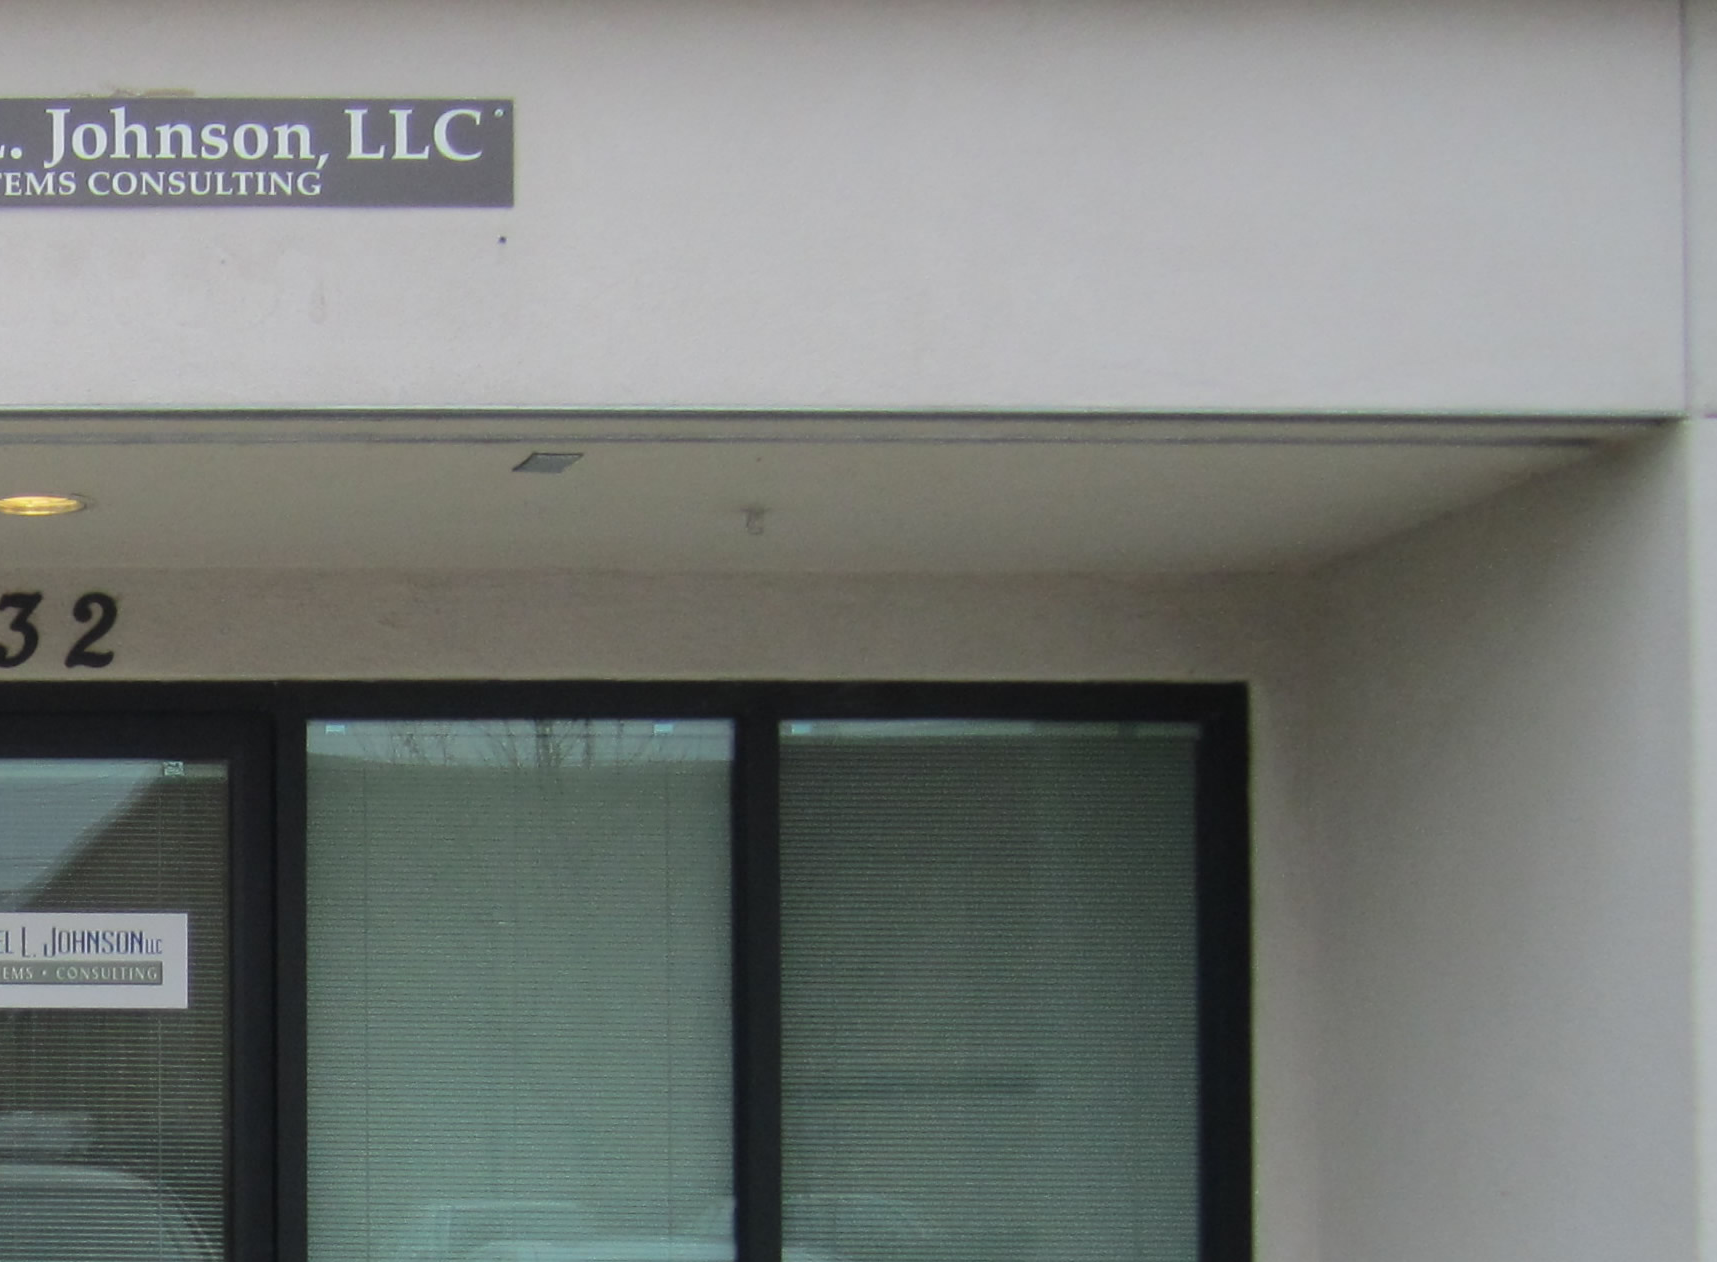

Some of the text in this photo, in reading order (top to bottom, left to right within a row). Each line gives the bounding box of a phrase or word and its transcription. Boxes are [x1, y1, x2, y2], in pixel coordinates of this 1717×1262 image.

[43, 106, 330, 170] Johnson,
[344, 107, 483, 161] LLC
[87, 171, 323, 196] CONSULTING
[56, 965, 158, 981] CONSULTING
